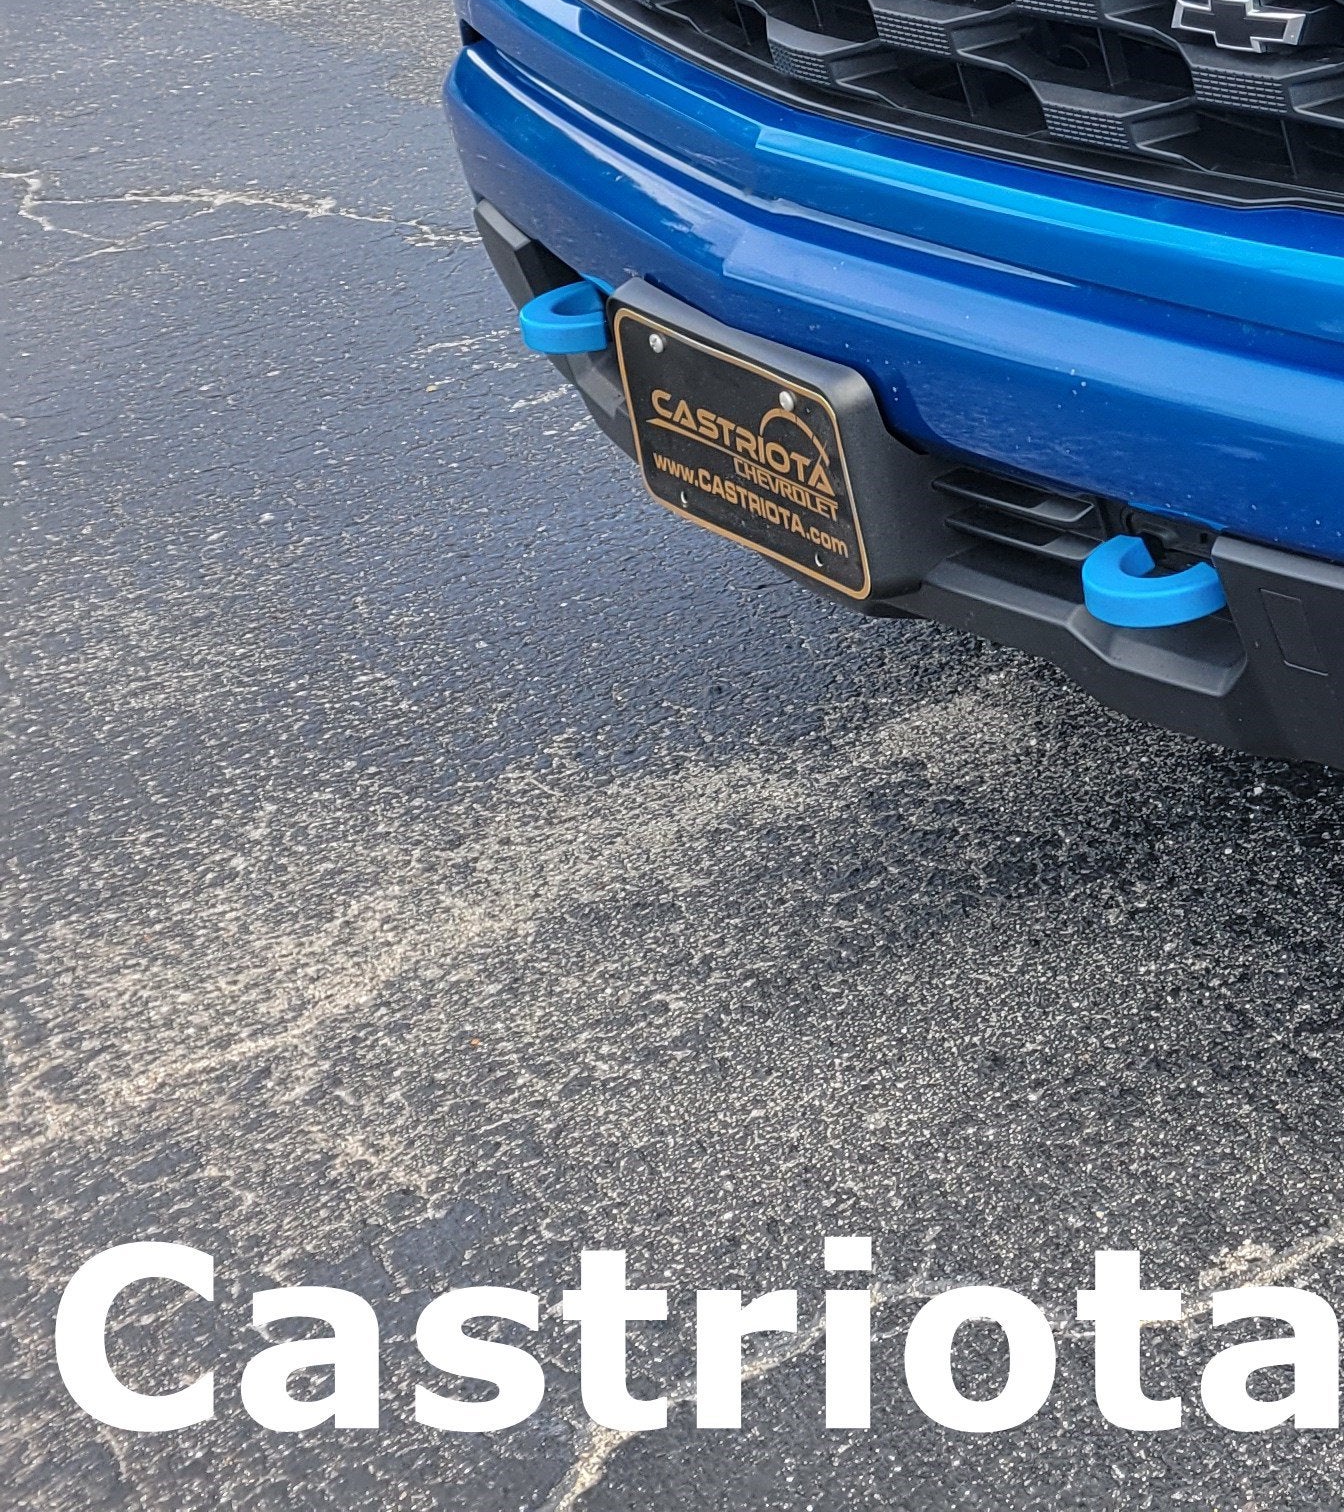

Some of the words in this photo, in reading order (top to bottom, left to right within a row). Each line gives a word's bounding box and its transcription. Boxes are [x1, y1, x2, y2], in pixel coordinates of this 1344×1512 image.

[651, 388, 836, 497] CASTRIOTA
[733, 456, 839, 522] CHEVROLET
[652, 452, 849, 559] www.CASTRIOTA.com
